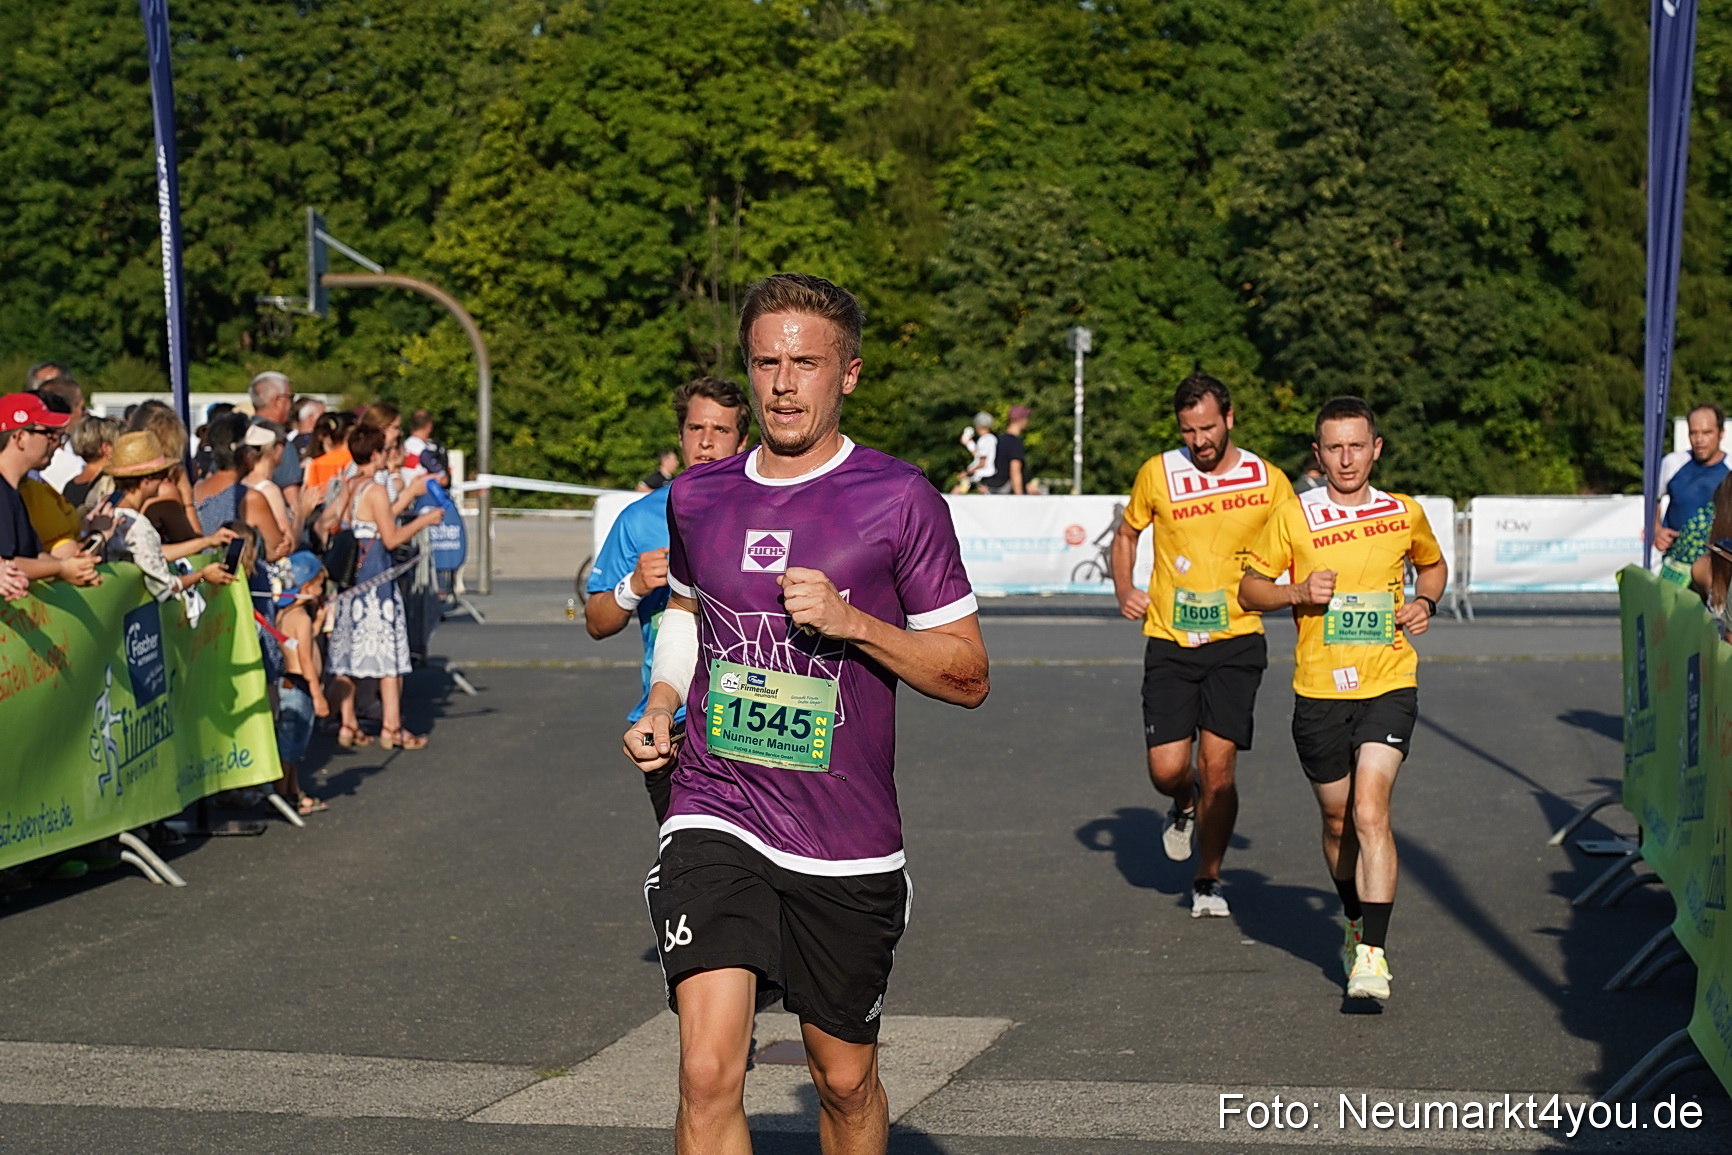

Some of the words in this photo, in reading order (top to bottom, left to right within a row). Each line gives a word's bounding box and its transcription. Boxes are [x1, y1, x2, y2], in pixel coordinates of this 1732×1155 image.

[1171, 501, 1216, 521] MAX
[1221, 492, 1270, 511] BÖGL
[1312, 528, 1359, 549] MAX
[1363, 519, 1411, 538] BÖGL
[747, 547, 786, 556] FUCHS
[1181, 604, 1220, 620] 1608
[1342, 611, 1378, 628] 979
[740, 684, 779, 695] Firmenlauf
[711, 704, 725, 737] RUN
[728, 697, 812, 740] 1545
[722, 728, 764, 747] Nunner
[767, 737, 810, 754] Manuel
[811, 716, 828, 760] 2022
[663, 913, 693, 953] 66
